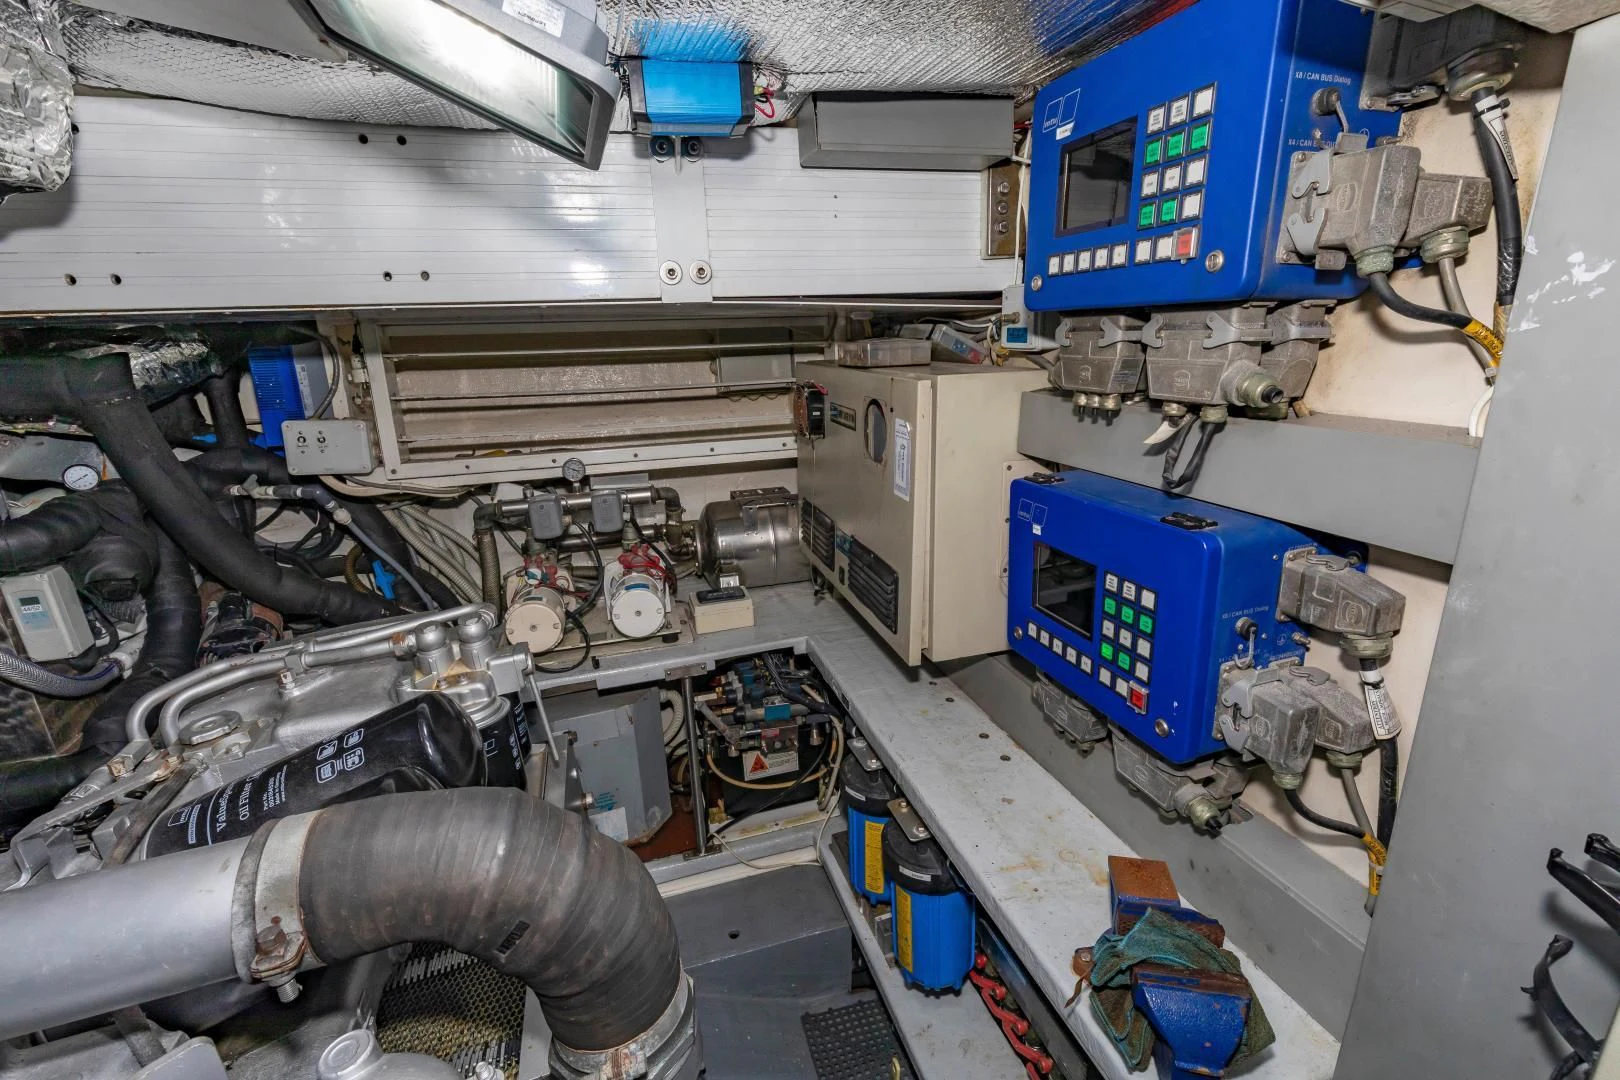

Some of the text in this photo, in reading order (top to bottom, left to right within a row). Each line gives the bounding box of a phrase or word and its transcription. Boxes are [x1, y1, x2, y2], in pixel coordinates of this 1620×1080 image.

[1307, 72, 1320, 81] CAN
[1321, 73, 1333, 82] BUS
[239, 782, 253, 821] Oil Filter
